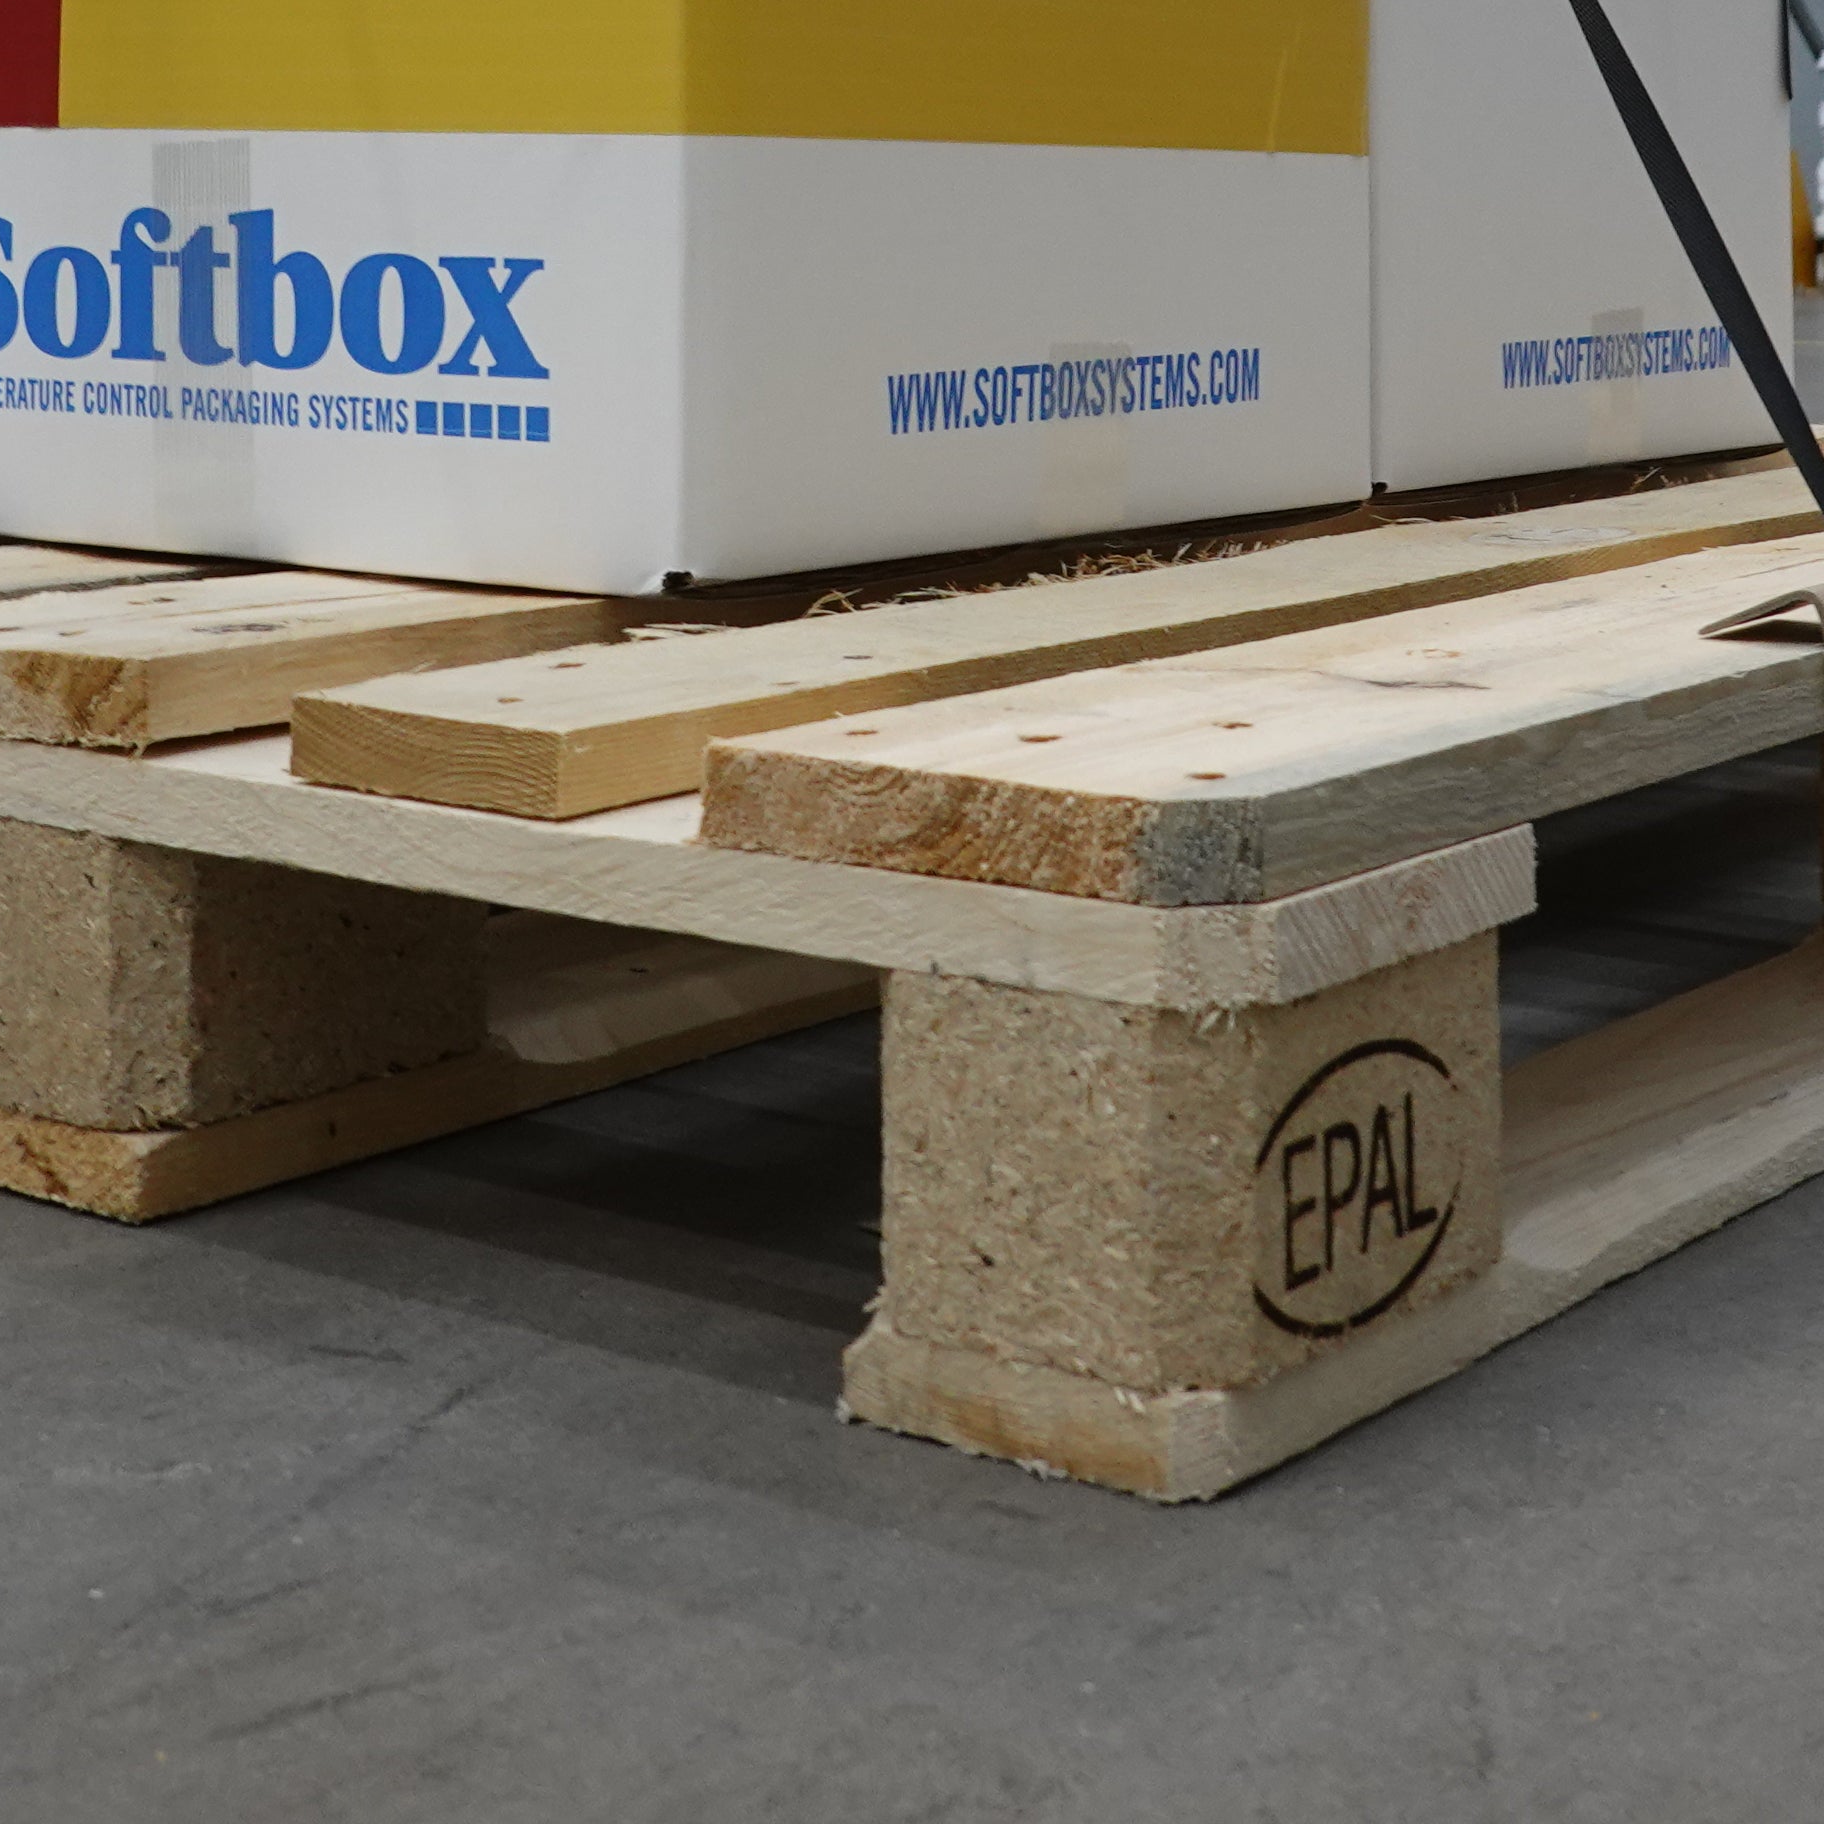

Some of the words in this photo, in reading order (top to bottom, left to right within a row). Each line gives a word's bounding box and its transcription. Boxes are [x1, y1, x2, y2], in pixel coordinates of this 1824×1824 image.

[888, 348, 1260, 435] WWW.SOFTBOXSYSTEMS.COM
[1502, 326, 1731, 389] WWW.SOFTBOXSYSTEMS.COM
[83, 381, 174, 420] CONTROL
[181, 386, 300, 428] PACKAGING
[308, 394, 410, 435] SYSTEMS
[1282, 1090, 1438, 1291] EPAL
